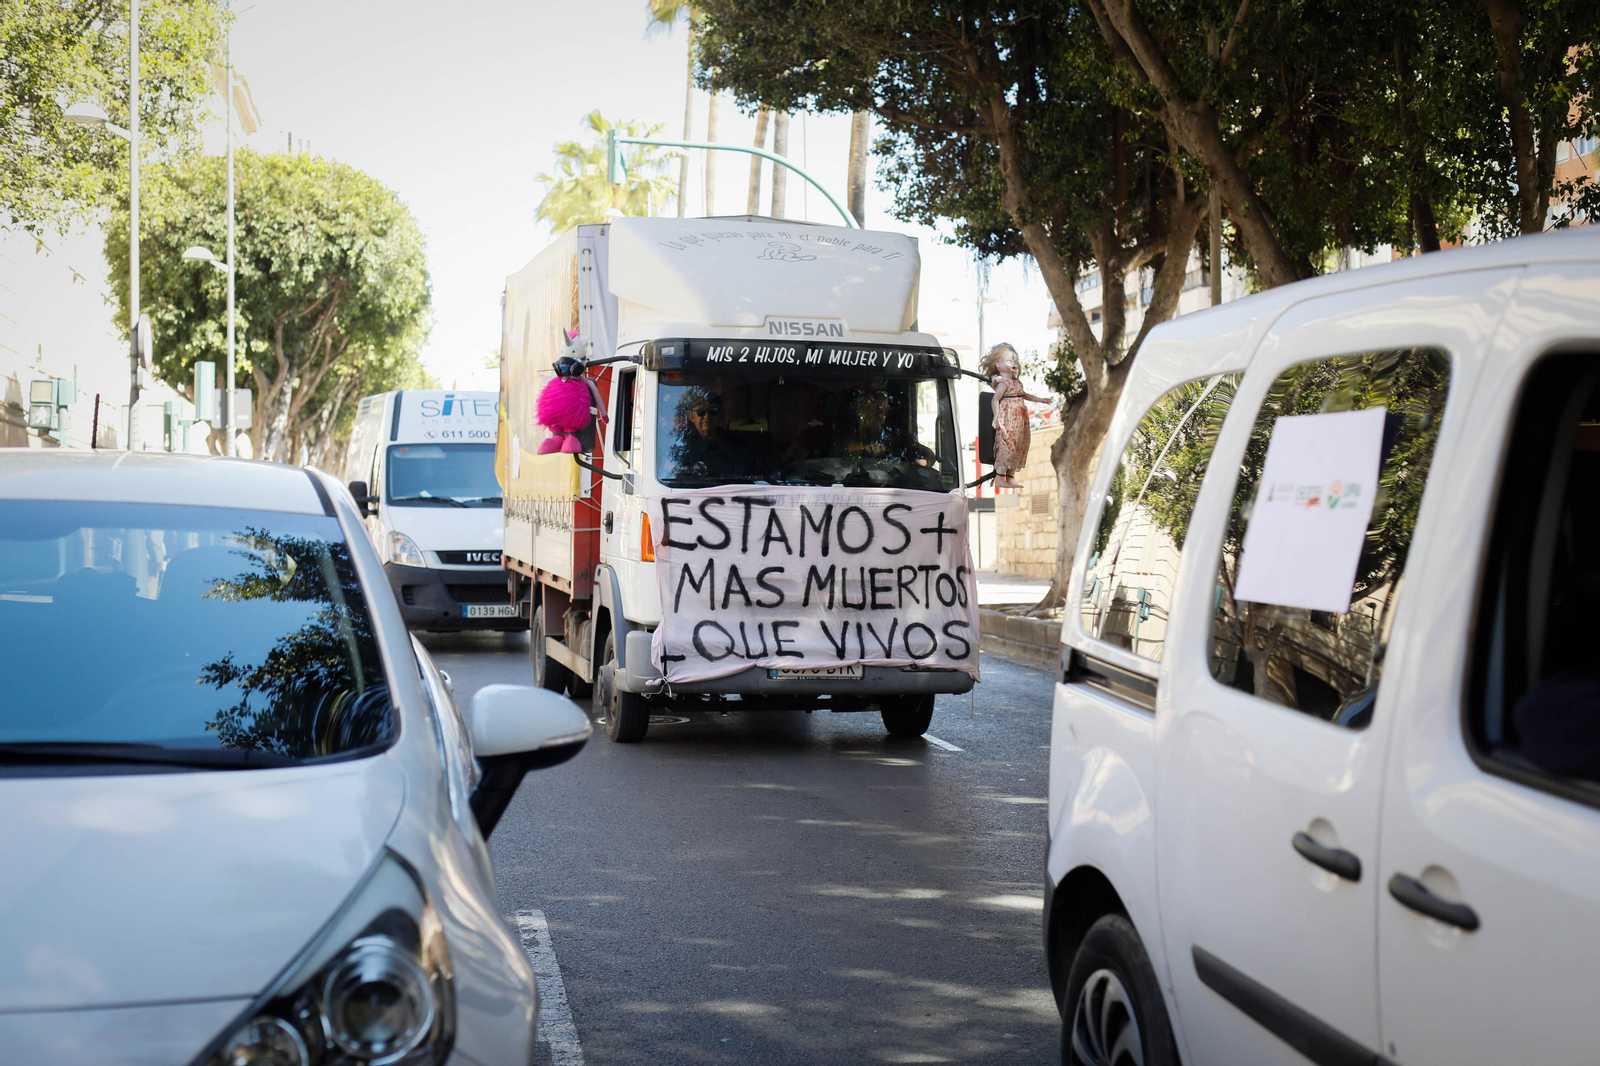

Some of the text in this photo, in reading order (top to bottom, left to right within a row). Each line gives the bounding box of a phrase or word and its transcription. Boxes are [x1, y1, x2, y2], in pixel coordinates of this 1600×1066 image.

[679, 234, 704, 247] que
[746, 231, 774, 241] para
[778, 231, 792, 240] Mi
[817, 235, 851, 247] Doble
[851, 243, 883, 255] para
[768, 321, 844, 337] NISSAN
[706, 346, 914, 369] MIS 2 HIJOS, MI MUJER Y YO
[442, 430, 463, 438] 611
[468, 430, 491, 438] 500
[467, 552, 503, 562] IVEC
[674, 558, 971, 614] MAS MUERTOS
[470, 606, 495, 616] 0139
[692, 619, 805, 662] QUE
[820, 617, 971, 662] VIVOS
